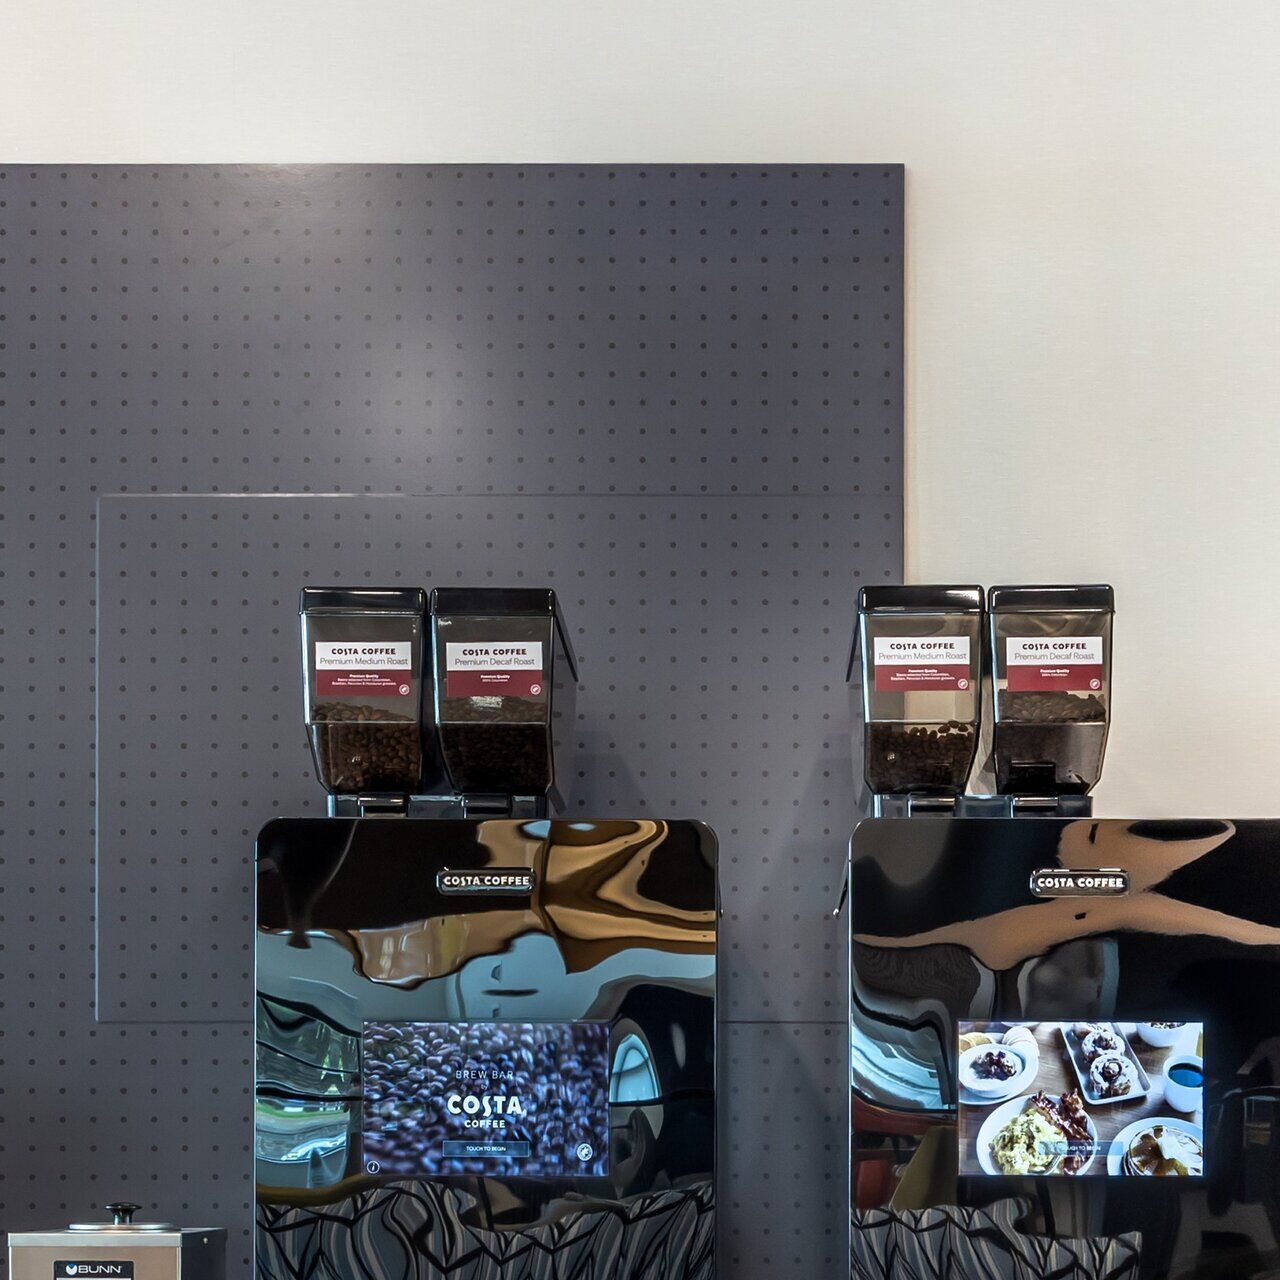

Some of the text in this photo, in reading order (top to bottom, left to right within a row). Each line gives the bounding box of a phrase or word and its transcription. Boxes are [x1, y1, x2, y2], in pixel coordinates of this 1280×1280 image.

[890, 643, 918, 651] COSTA
[1022, 643, 1050, 651] COSTA
[331, 648, 359, 656] COSTA
[493, 648, 527, 656] COFFEE
[914, 652, 944, 660] Medium
[945, 652, 967, 660] Roast
[1050, 652, 1072, 660] Decaf
[1074, 652, 1095, 660] Roast
[320, 657, 408, 665] Premium Medium Roast
[444, 876, 530, 886] COSTA COFFEE
[1037, 878, 1124, 888] COSTA COFFEE
[455, 1070, 514, 1079] BREW BAR
[447, 1095, 523, 1117] COSTA
[464, 1120, 506, 1128] COFFEE
[78, 1265, 121, 1274] BUNN
